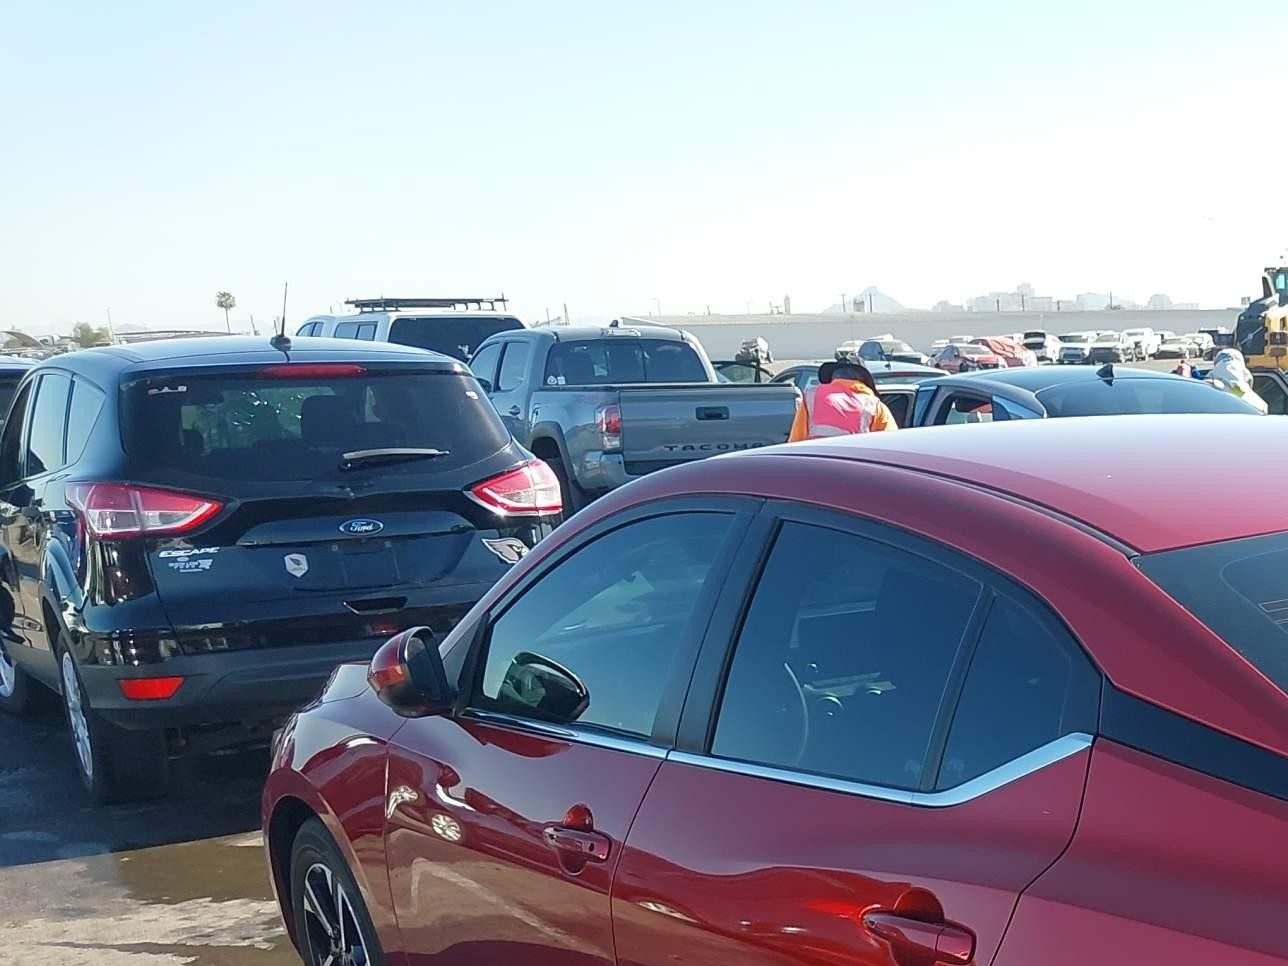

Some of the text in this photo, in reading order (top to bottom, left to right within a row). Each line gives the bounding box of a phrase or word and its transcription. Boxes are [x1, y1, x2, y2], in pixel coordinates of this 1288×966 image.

[664, 442, 764, 452] TACOMA
[350, 521, 374, 532] Ford
[158, 546, 220, 558] ESCAPE
